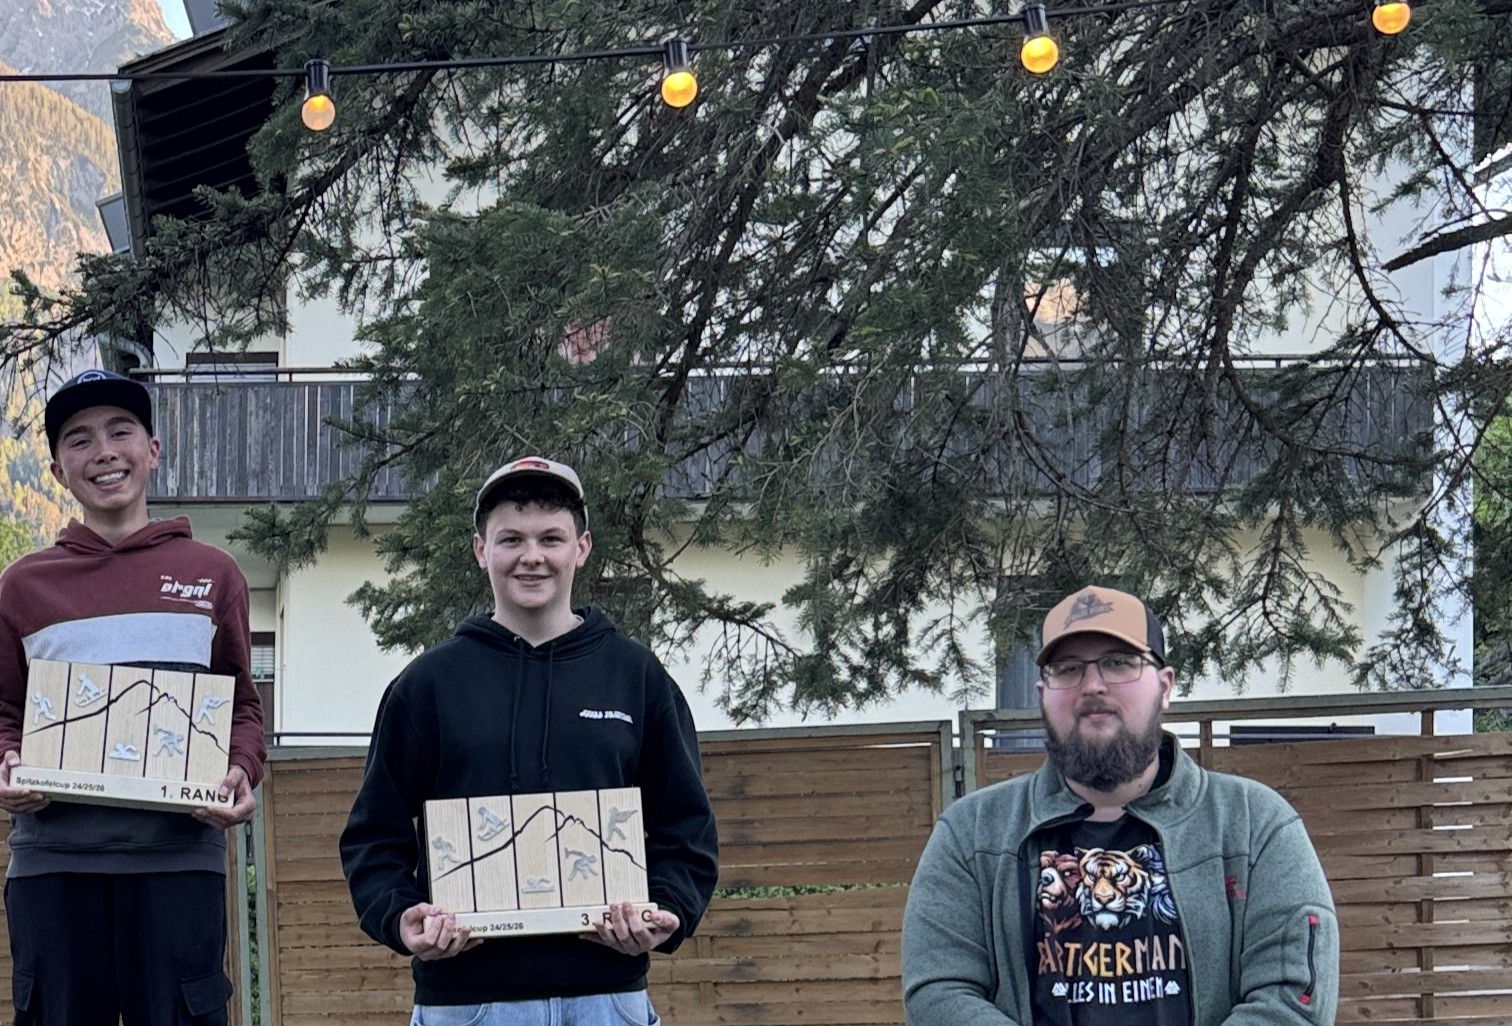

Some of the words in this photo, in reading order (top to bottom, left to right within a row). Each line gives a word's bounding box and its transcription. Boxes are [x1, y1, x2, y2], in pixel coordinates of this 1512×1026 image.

[602, 909, 654, 925] RG
[489, 922, 524, 932] 24/25/26
[1098, 982, 1117, 1004] IN
